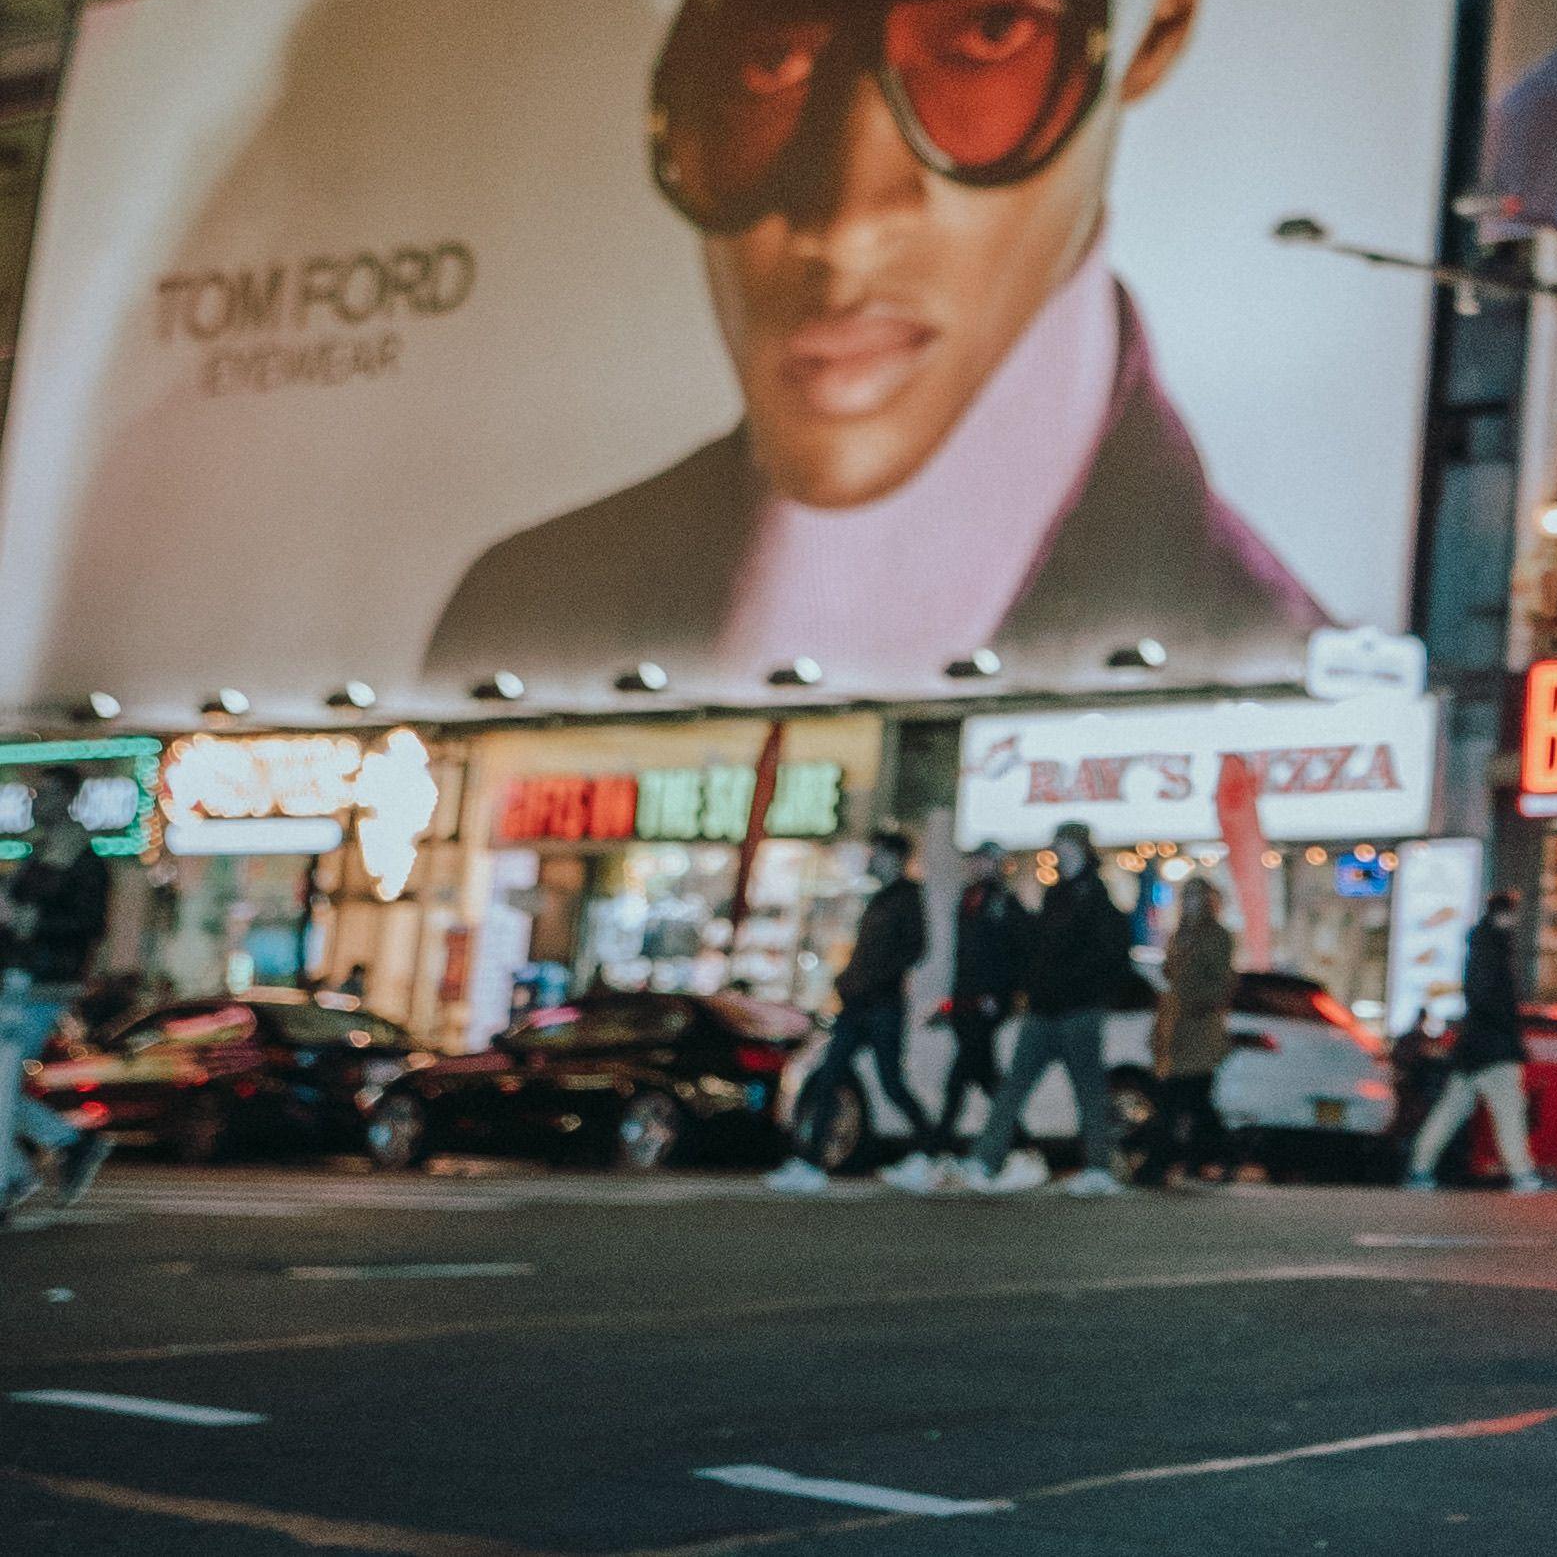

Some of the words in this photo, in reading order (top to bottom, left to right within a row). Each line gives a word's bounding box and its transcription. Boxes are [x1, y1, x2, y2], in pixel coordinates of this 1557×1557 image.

[156, 261, 288, 340] TOM
[295, 240, 478, 330] FORD
[1024, 752, 1195, 805] RAY'S
